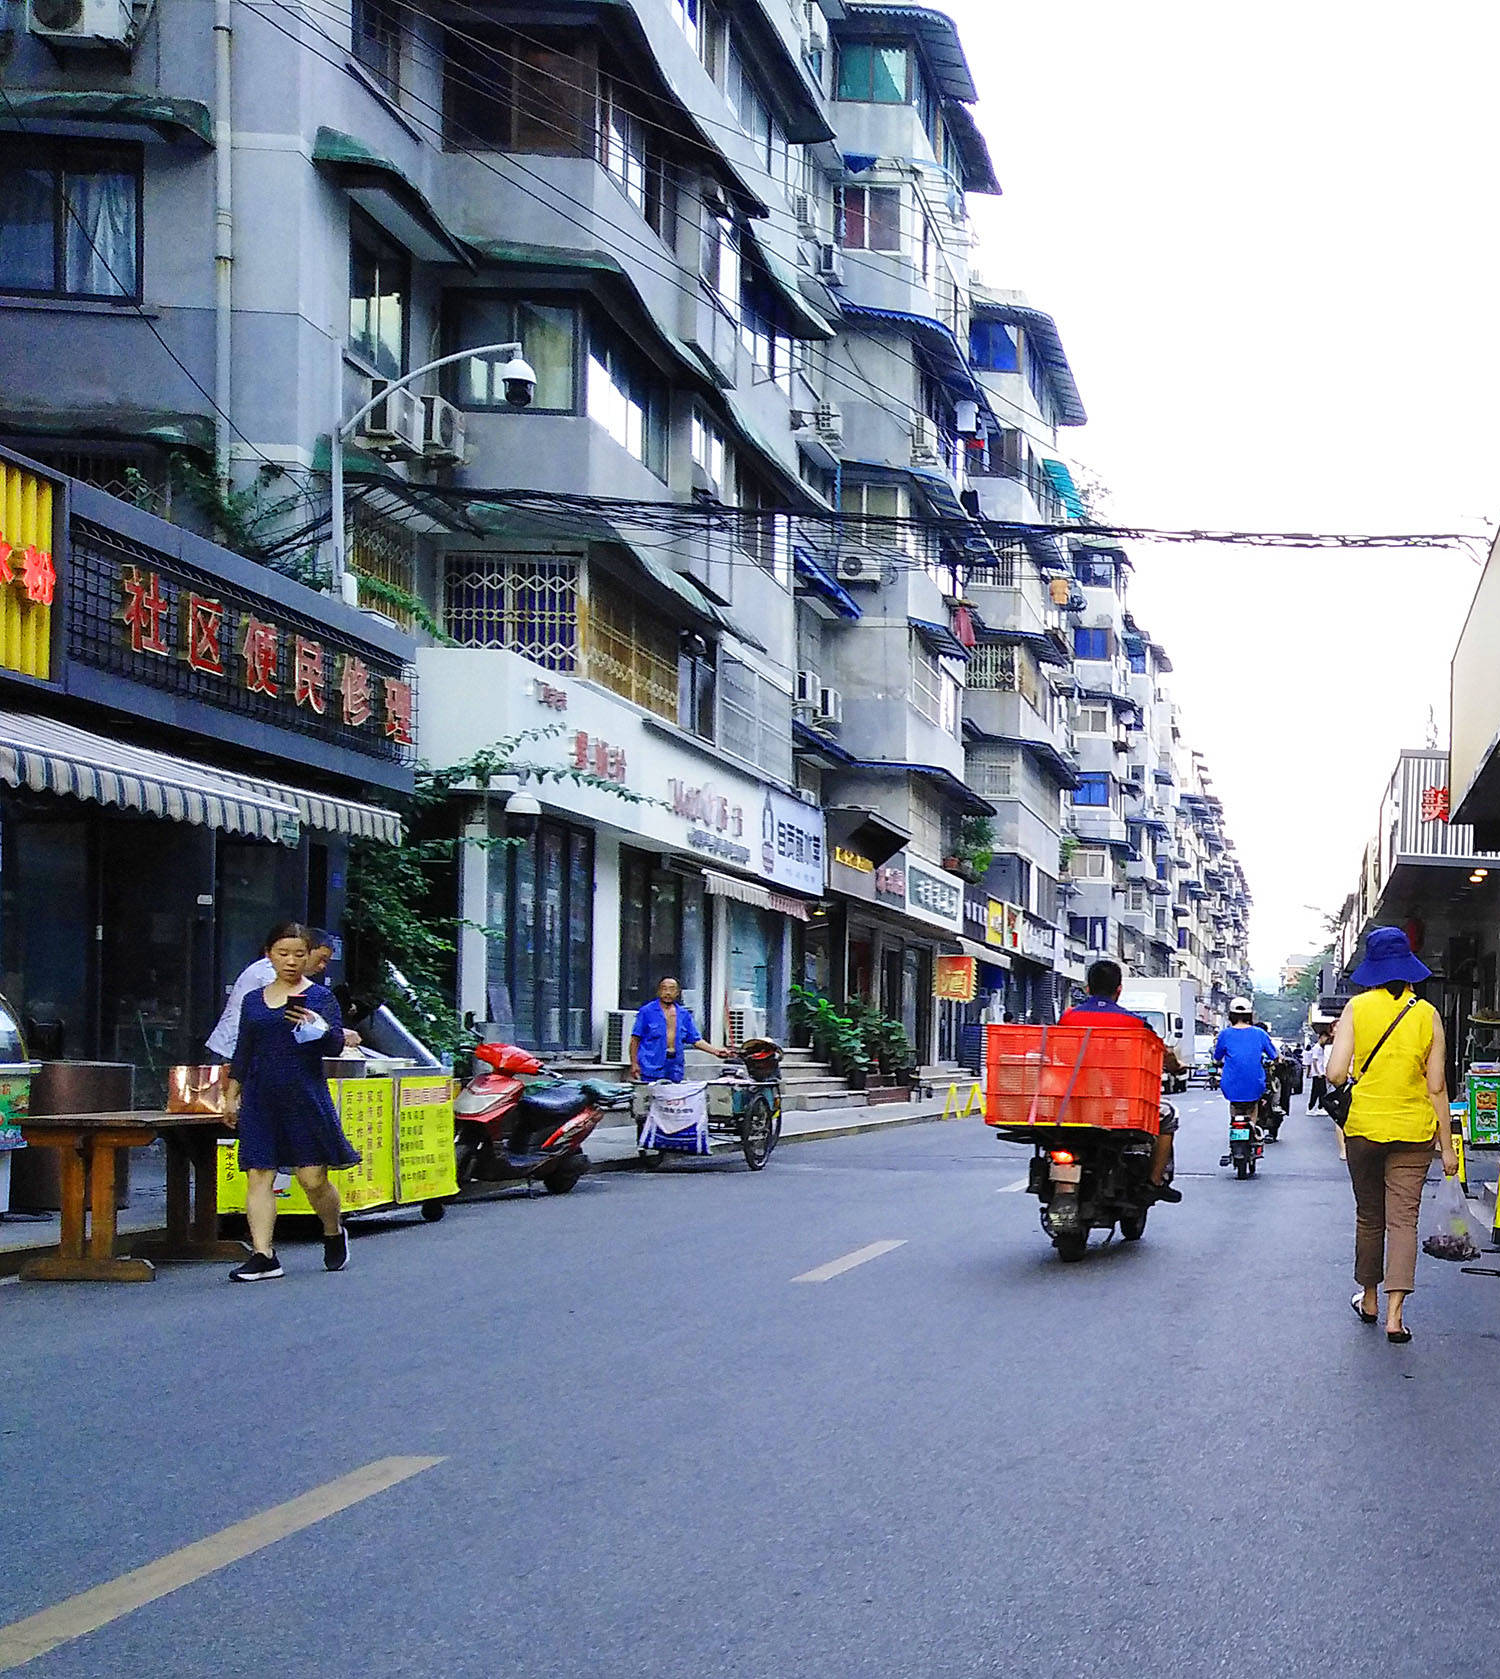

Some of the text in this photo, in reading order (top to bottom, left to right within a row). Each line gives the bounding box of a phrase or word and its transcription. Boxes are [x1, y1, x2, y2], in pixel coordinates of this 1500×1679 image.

[122, 564, 413, 746] 社区便民修理
[943, 970, 971, 995] 酒
